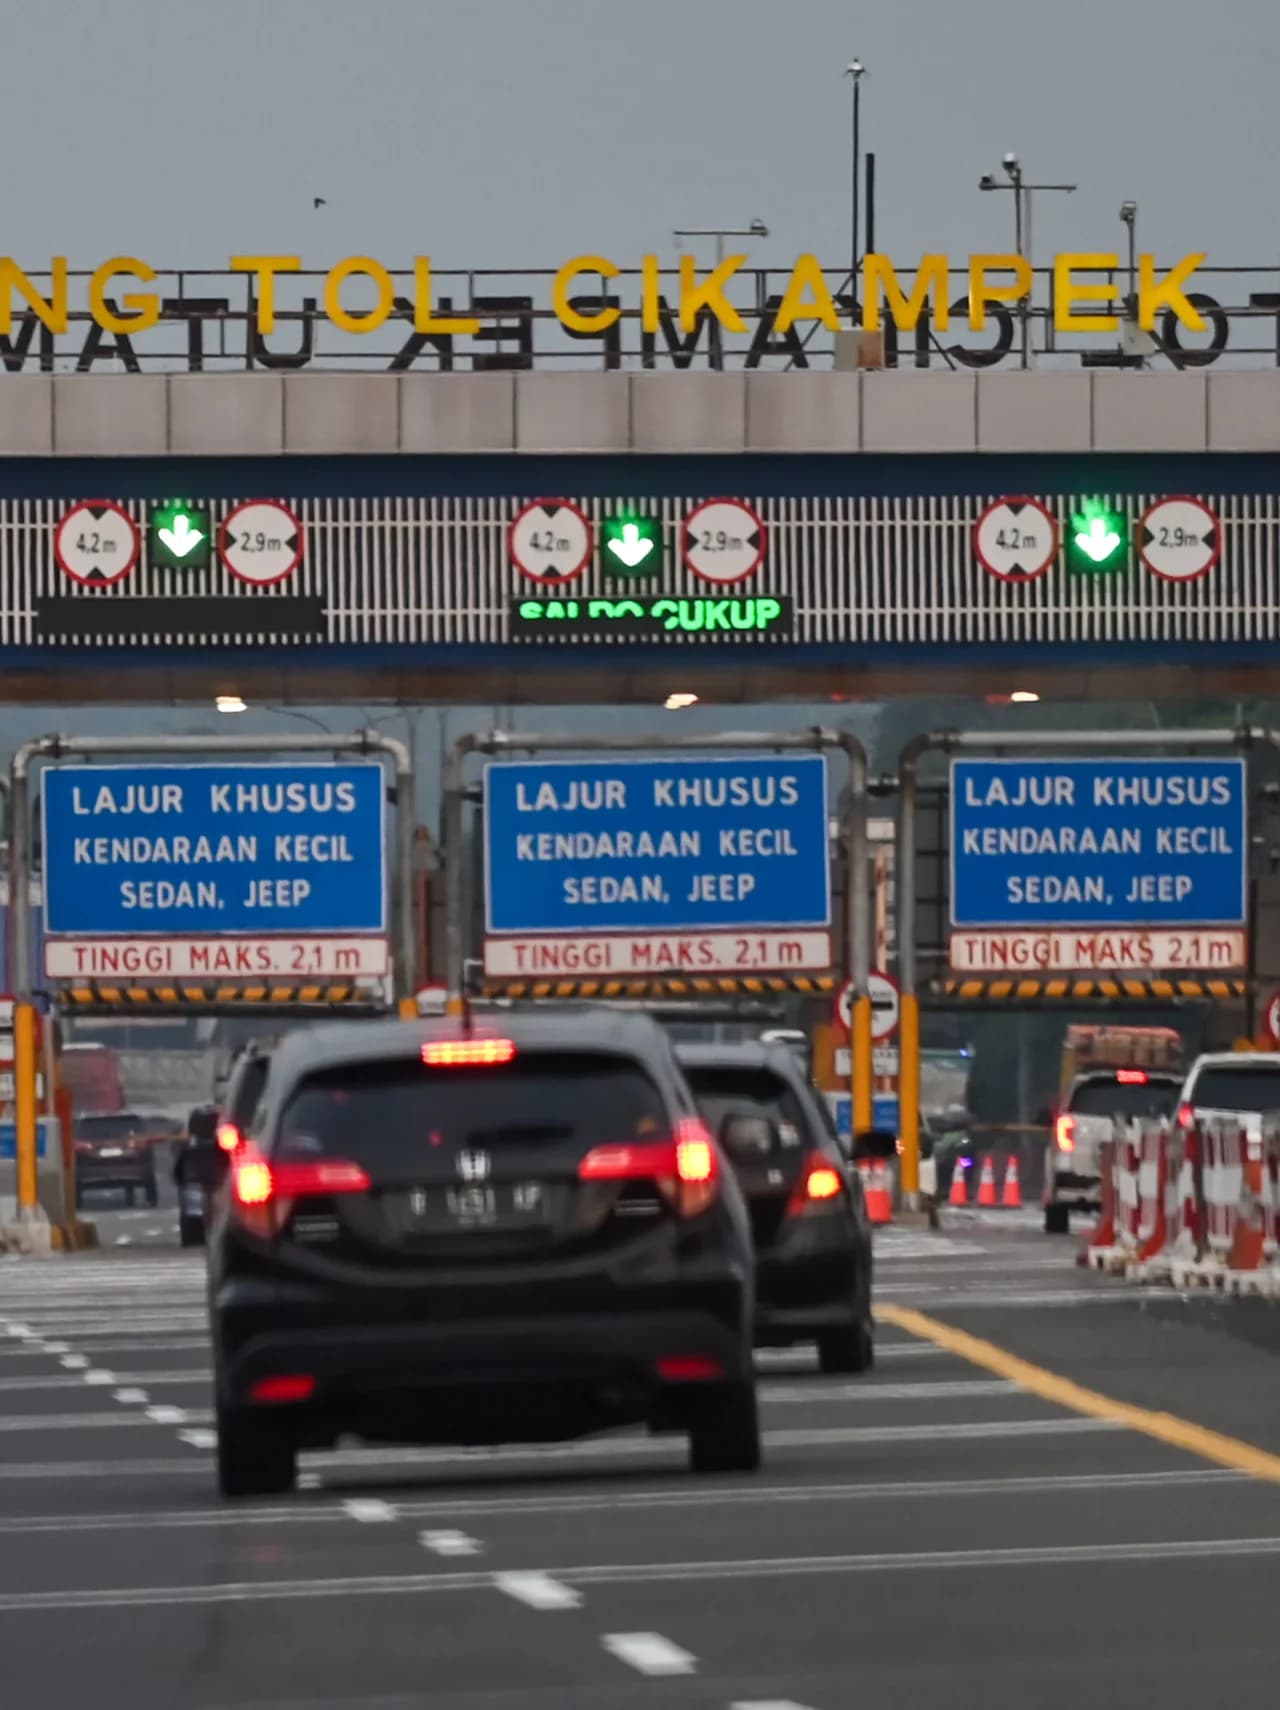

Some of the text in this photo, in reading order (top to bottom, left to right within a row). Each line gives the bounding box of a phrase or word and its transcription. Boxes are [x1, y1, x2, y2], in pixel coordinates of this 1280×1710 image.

[230, 254, 480, 334] TOL
[551, 252, 1208, 333] CIKAMPEK
[73, 782, 356, 814] LAJUR KHUSUS
[516, 776, 799, 811] LAJUR KHUSUS
[966, 776, 1230, 806] LAJUR KHUSUS
[74, 835, 353, 864] KENDARAAN KECIL
[517, 828, 797, 861] KENDARAAN KECIL
[963, 827, 1232, 855] KENDARAAN KECIL
[243, 879, 310, 907] JEEP
[688, 874, 755, 902] JEEP
[1126, 875, 1192, 902] JEEP
[73, 946, 173, 972] TINGGI
[512, 944, 612, 969] TINGGI
[964, 939, 1060, 966] TINGGI
